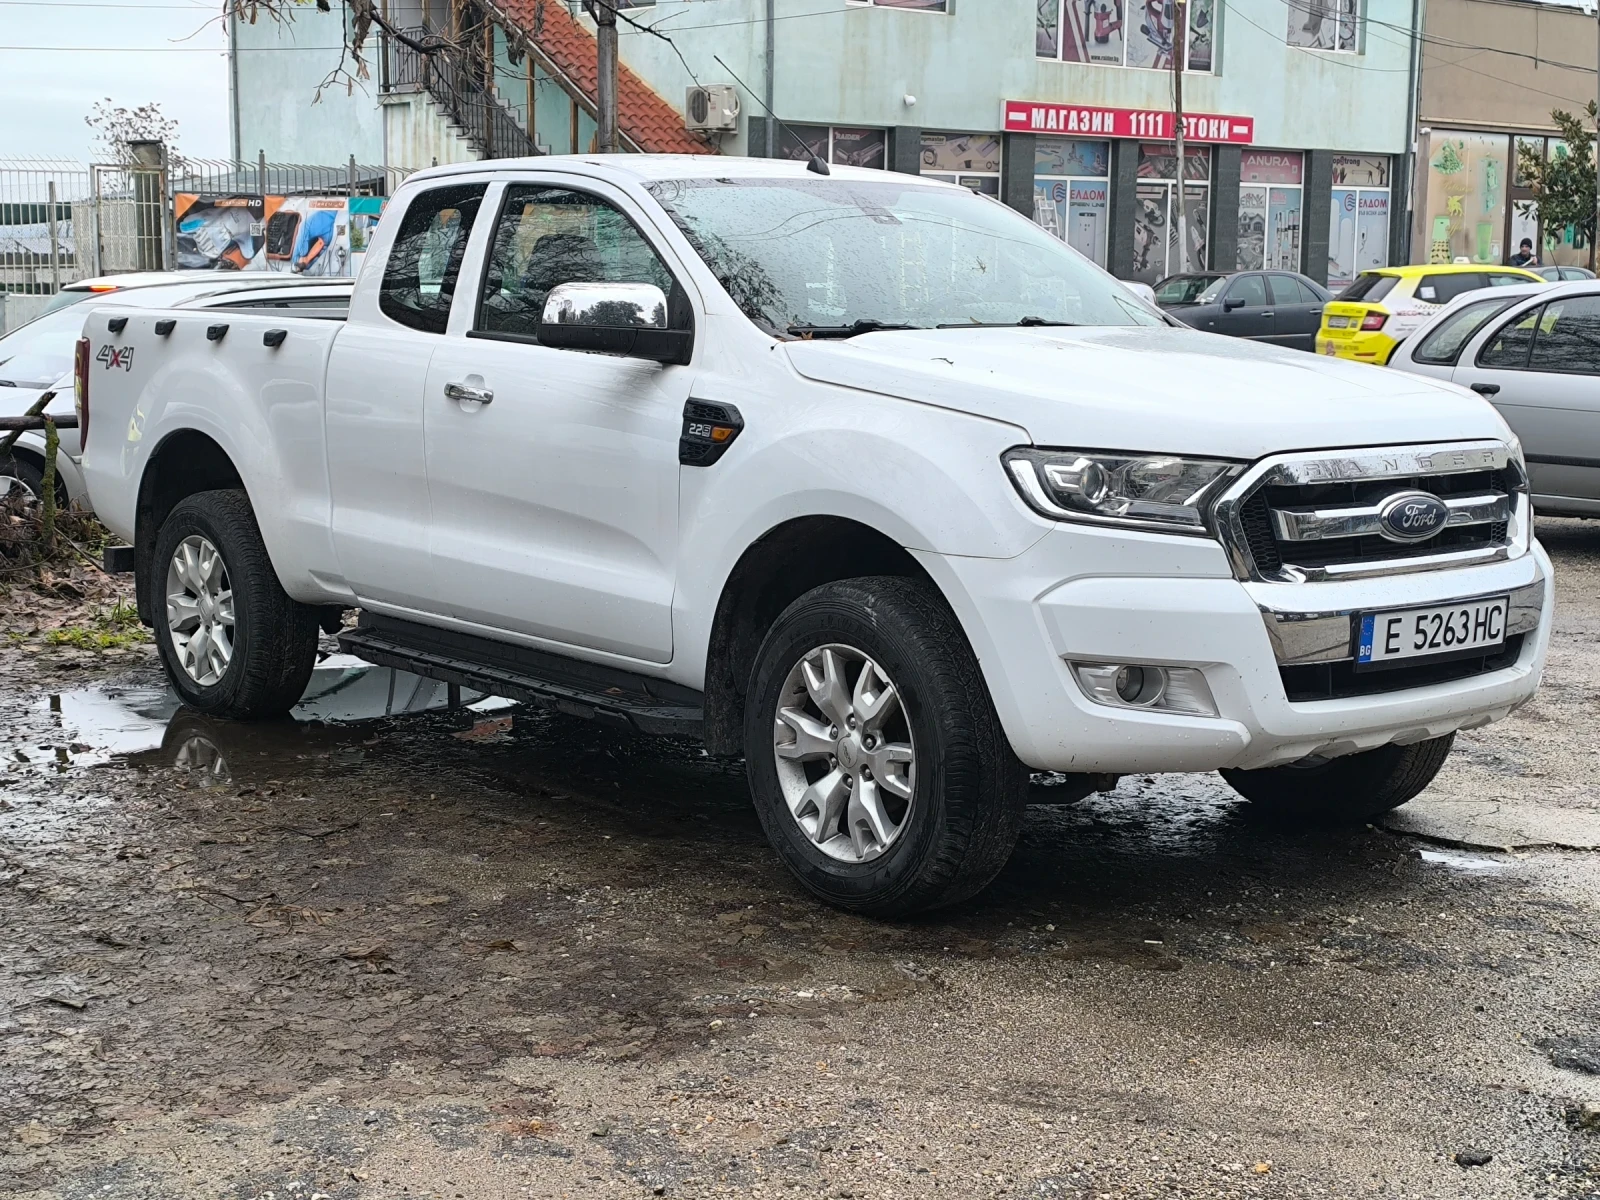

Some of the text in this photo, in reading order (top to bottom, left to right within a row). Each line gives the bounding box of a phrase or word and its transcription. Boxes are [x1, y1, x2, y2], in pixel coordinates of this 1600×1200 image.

[1031, 107, 1114, 132] МАГАЗИН
[1129, 112, 1163, 136] 1111
[1247, 155, 1290, 167] ANURA
[247, 199, 262, 207] HD
[1303, 451, 1495, 478] RANGER
[1402, 503, 1437, 529] Ford
[1384, 616, 1403, 655] E
[1359, 644, 1371, 657] BG
